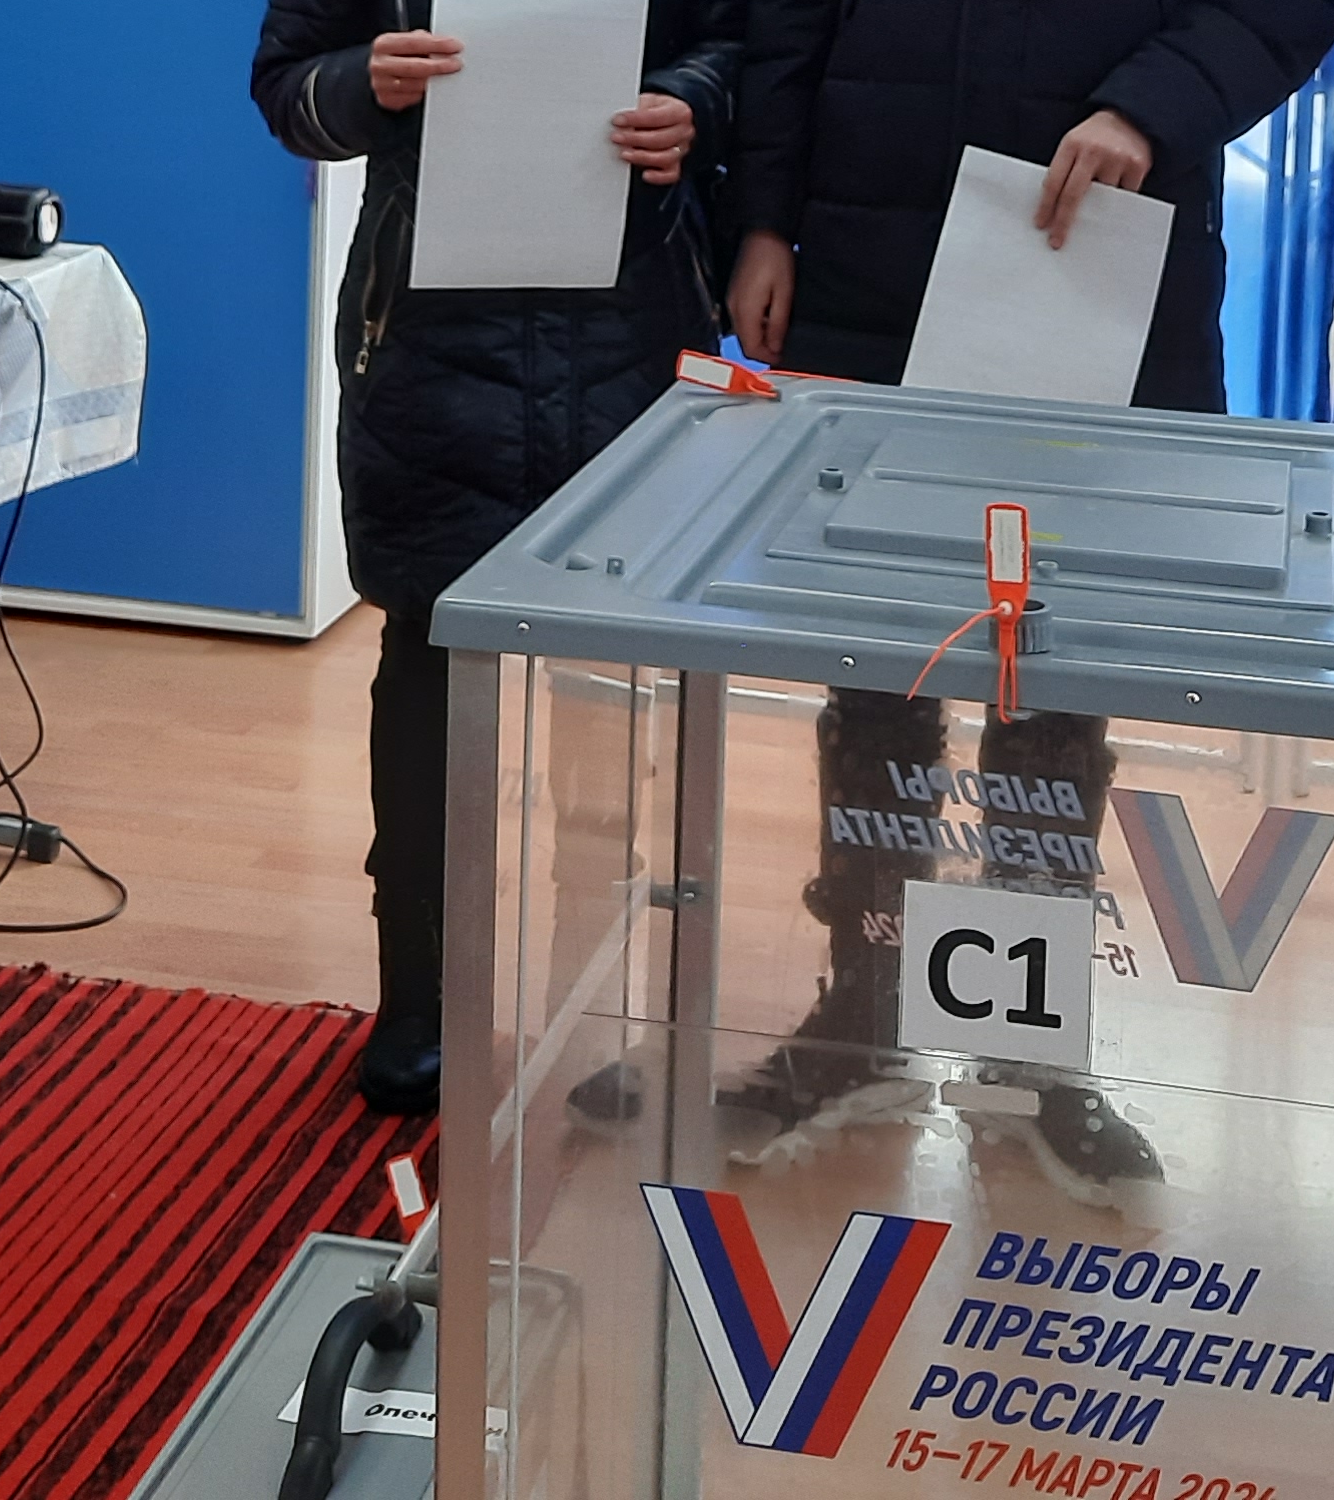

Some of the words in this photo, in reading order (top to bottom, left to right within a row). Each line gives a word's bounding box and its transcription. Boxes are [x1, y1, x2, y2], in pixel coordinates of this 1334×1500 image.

[927, 927, 1064, 1031] С1
[975, 1231, 1262, 1317] ВЫБОРЫ
[909, 1362, 1166, 1447] РОССИИ
[1009, 1446, 1162, 1500] МАРТА
